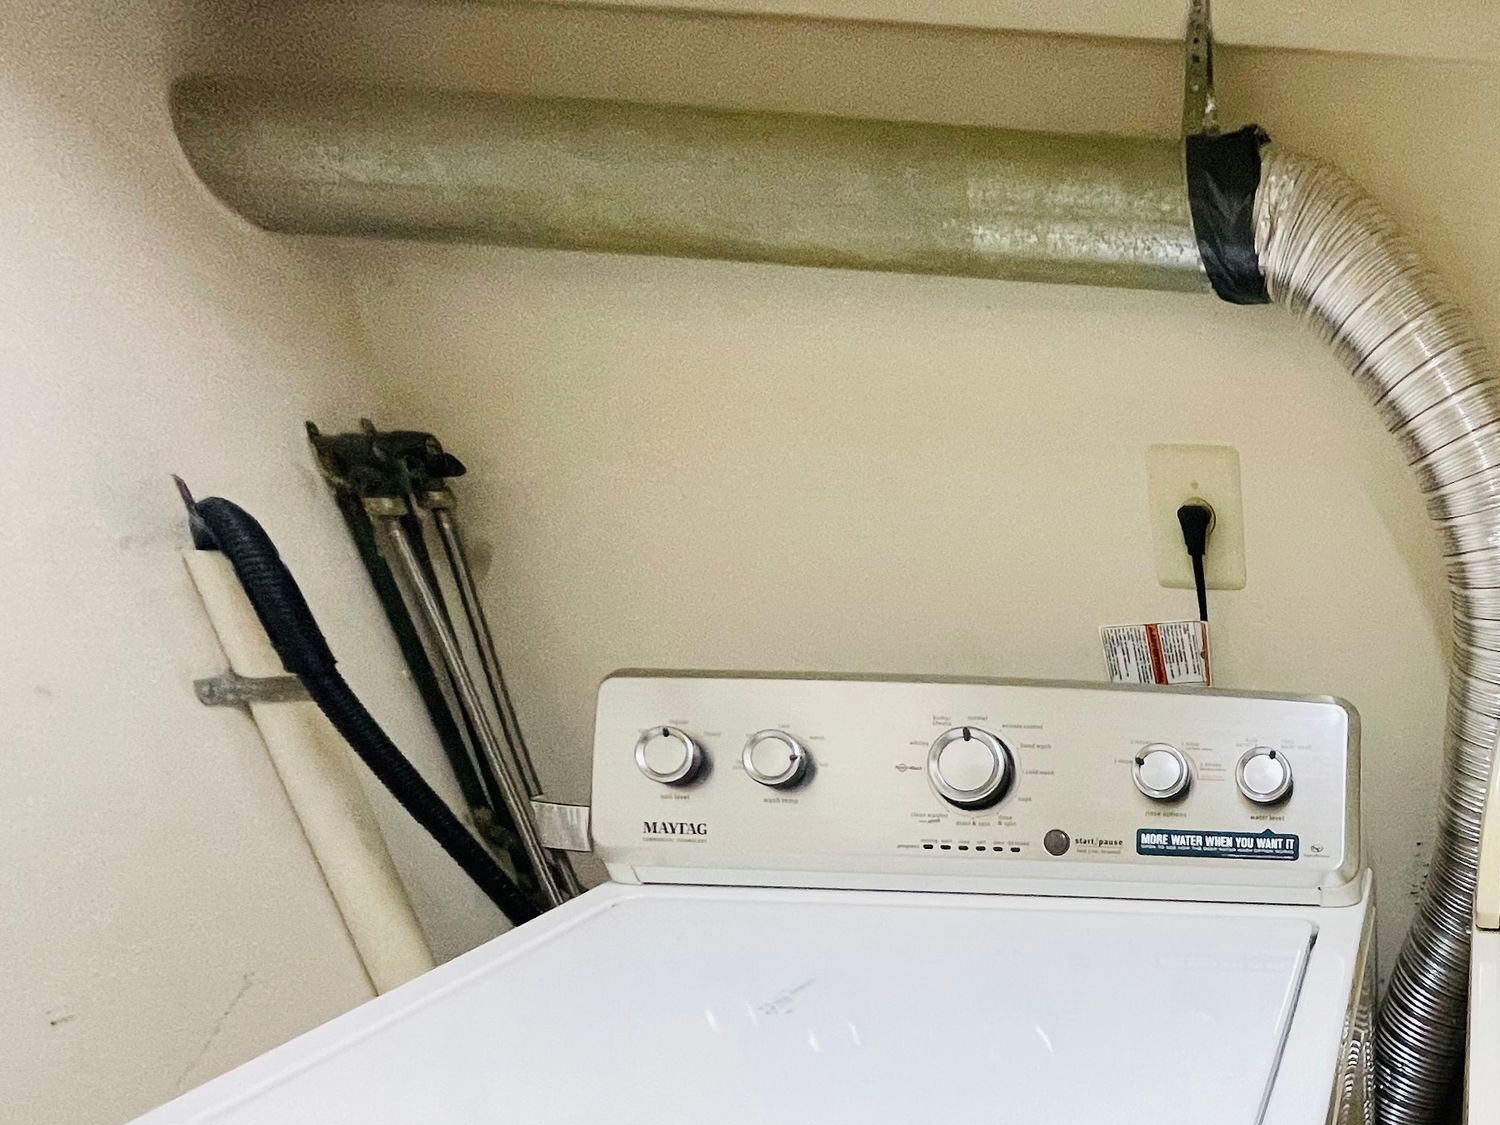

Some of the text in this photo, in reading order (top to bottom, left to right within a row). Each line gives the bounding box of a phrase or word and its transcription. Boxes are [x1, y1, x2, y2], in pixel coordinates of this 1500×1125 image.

[642, 821, 708, 836] MAYTAG
[1140, 833, 1295, 849] MORE WATER WHEN YOU WANT IT
